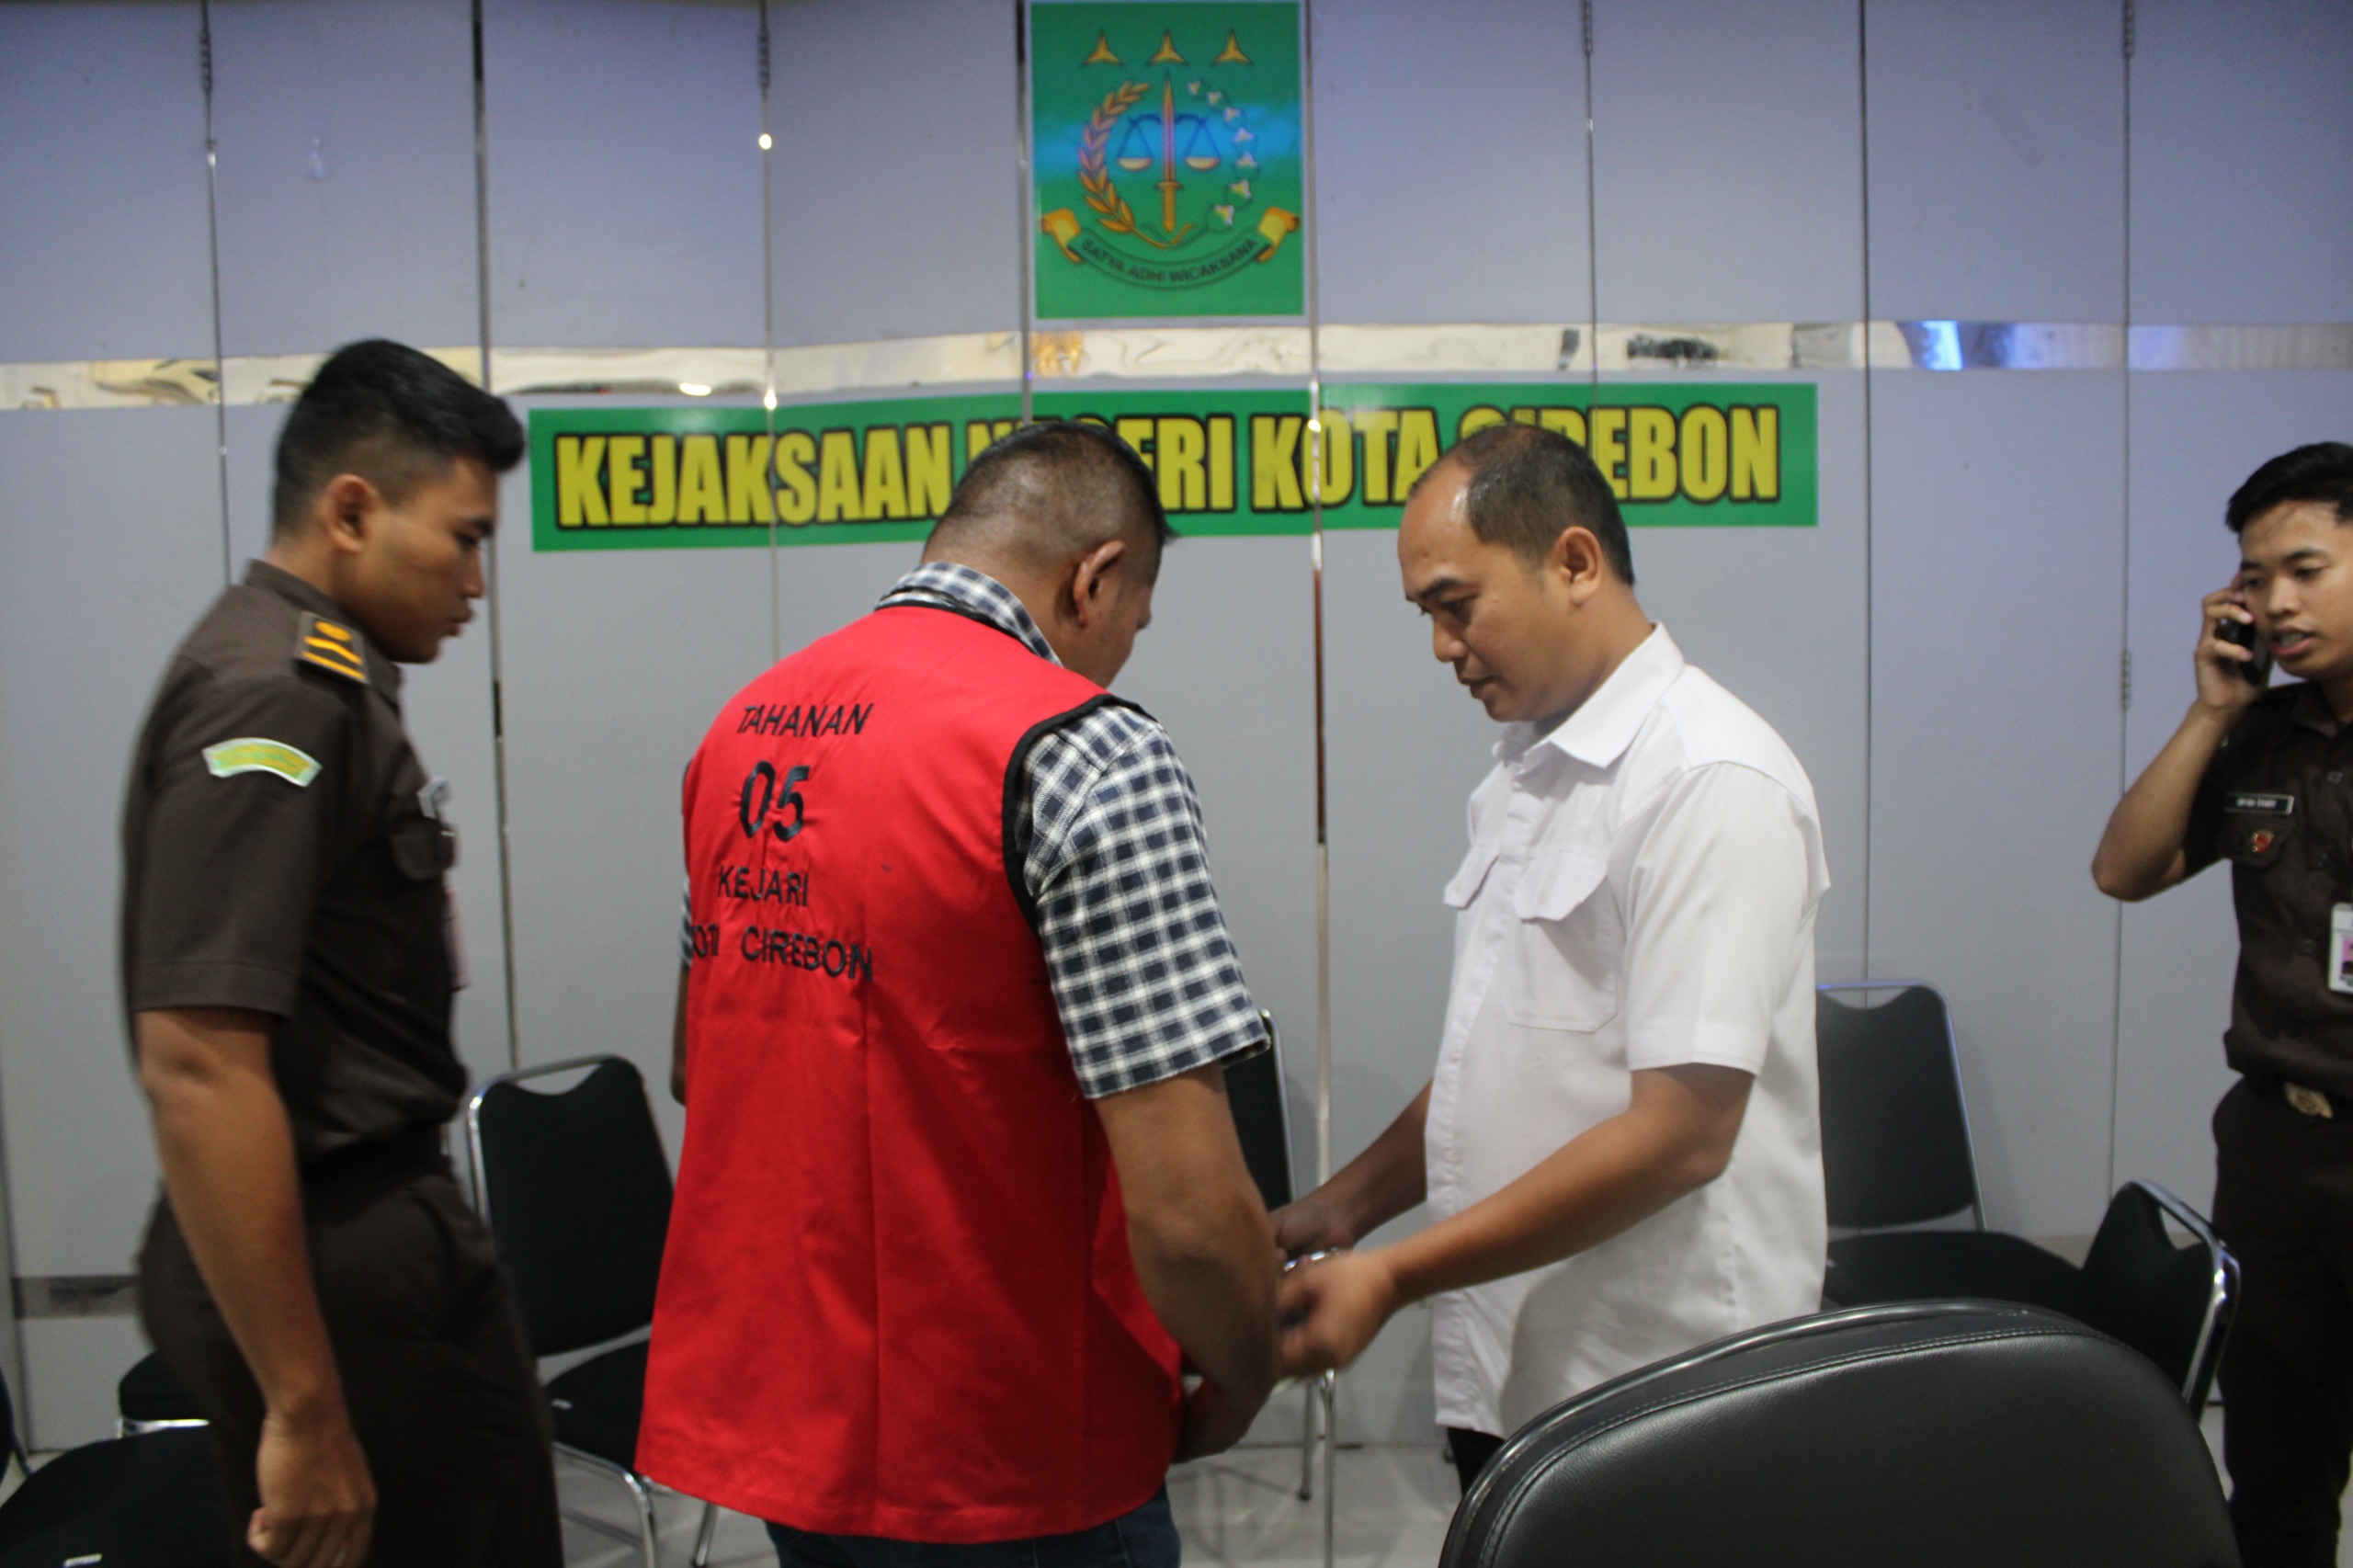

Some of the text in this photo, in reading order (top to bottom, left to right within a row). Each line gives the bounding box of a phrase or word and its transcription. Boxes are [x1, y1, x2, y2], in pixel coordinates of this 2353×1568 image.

[1128, 265, 1165, 283] ADHI
[555, 424, 954, 529] KEJAKSAAN
[1248, 404, 1442, 513] KOTA
[1459, 403, 1780, 506] EBON
[737, 703, 874, 737] TAHANAN
[740, 760, 811, 842] 05
[717, 865, 809, 907] KEJARI
[741, 925, 872, 983] CIREBON
